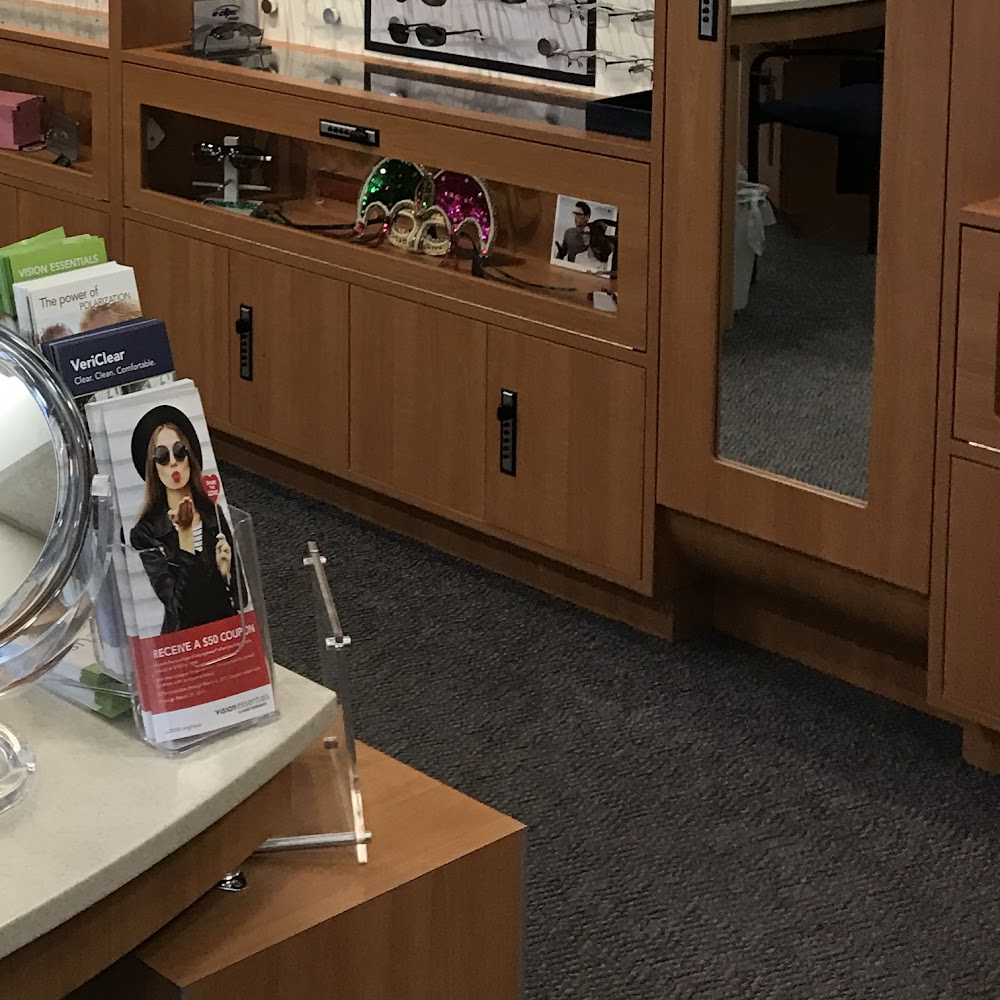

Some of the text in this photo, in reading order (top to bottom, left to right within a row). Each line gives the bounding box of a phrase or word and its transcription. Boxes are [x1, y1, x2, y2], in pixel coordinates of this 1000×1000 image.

[18, 253, 99, 278] VISION ESSENTIALS
[39, 285, 99, 309] The power of
[79, 292, 132, 310] POLARIZATION
[70, 351, 125, 372] VeriClear
[74, 359, 157, 385] Clear. Clean. Comfortable.
[153, 623, 256, 659] RECEIVE A $50 COUPON
